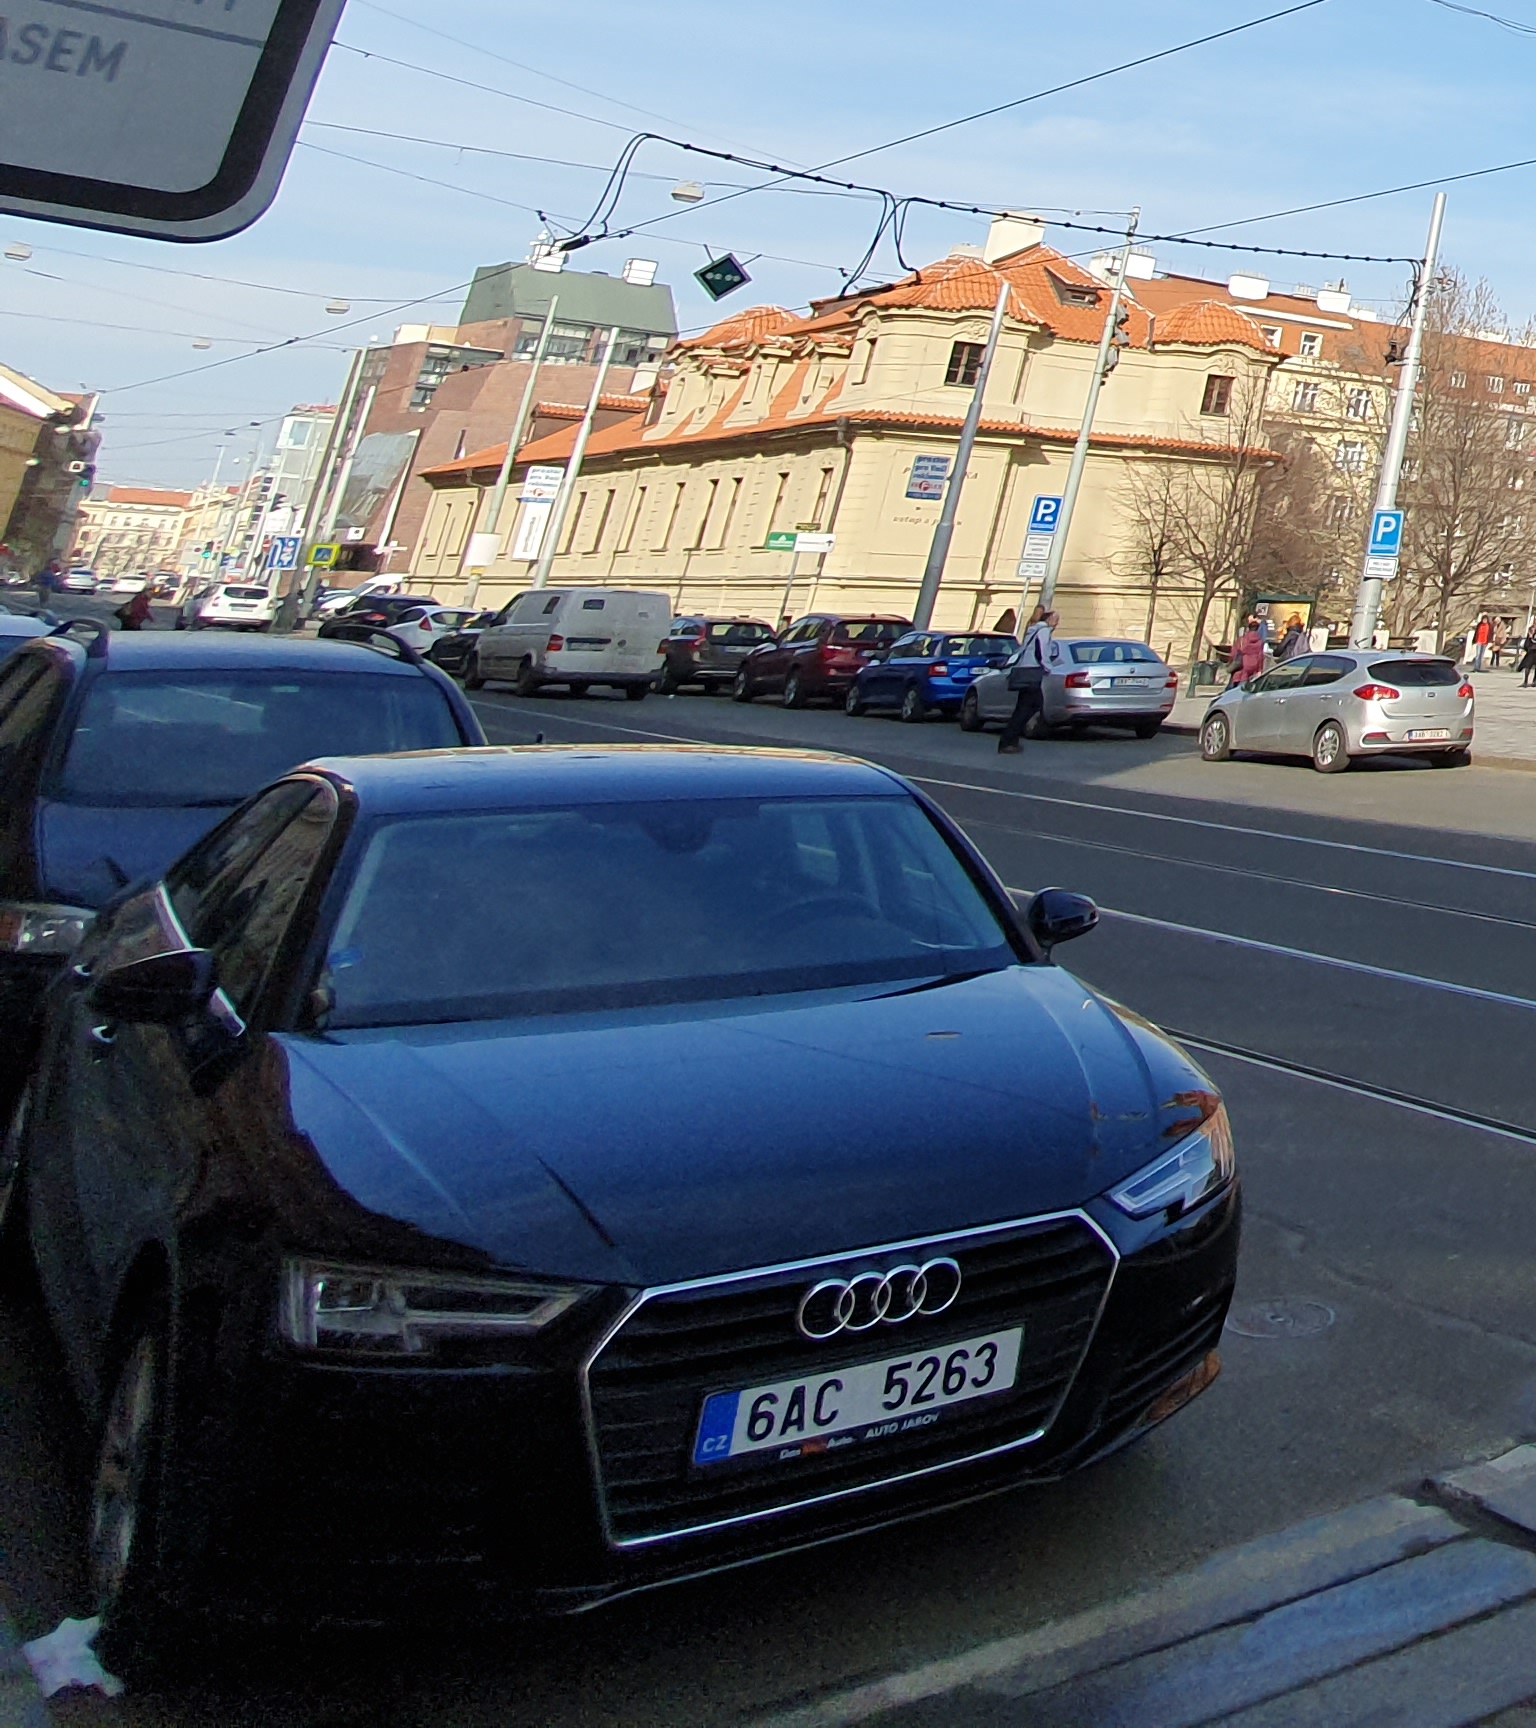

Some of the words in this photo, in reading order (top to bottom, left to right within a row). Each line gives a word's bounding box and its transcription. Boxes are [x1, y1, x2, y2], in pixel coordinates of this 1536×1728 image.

[0, 16, 128, 83] SEM
[746, 1378, 844, 1442] 6AC
[881, 1341, 999, 1411] 5263
[702, 1434, 728, 1454] CZ
